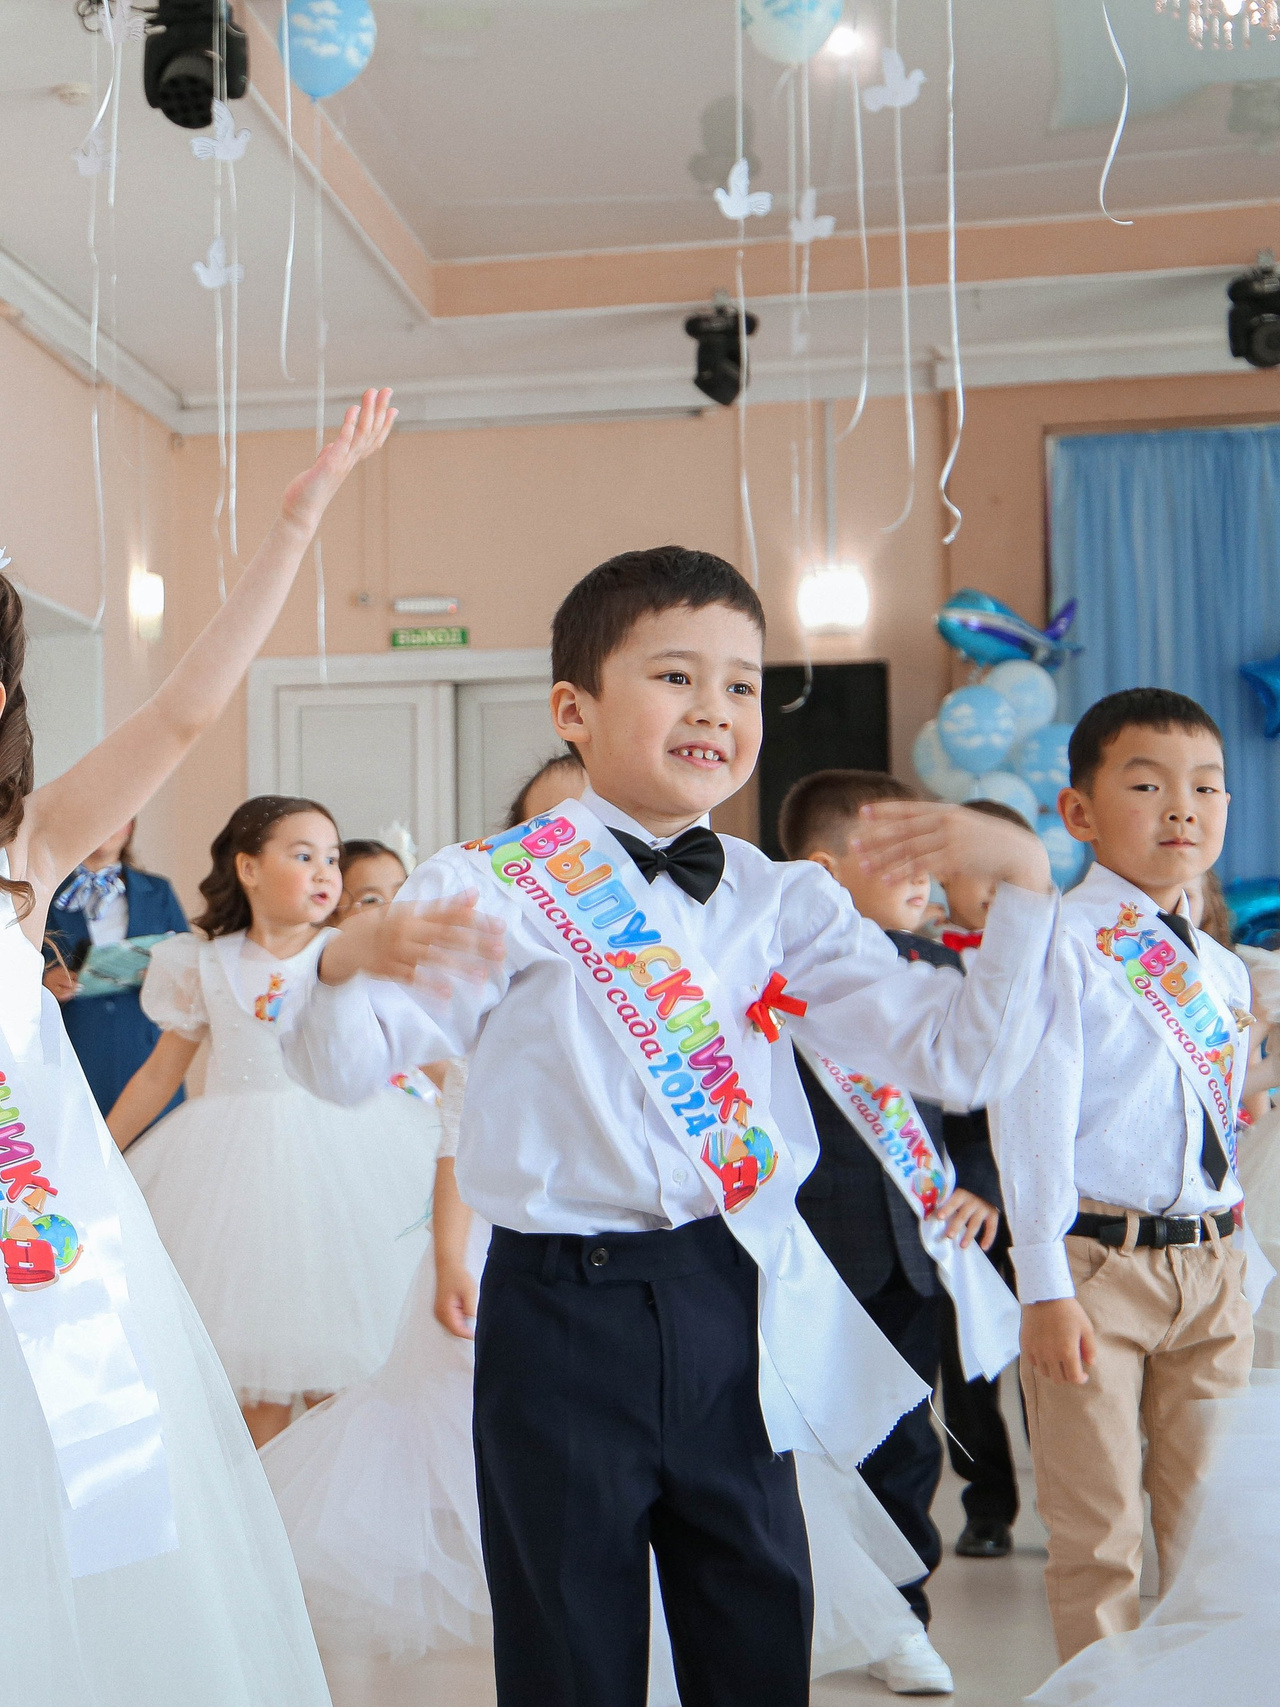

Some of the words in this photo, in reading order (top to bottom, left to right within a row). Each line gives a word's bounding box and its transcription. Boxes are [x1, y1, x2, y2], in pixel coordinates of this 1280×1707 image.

[502, 861, 613, 983] детского
[607, 987, 662, 1060] сада
[648, 1052, 719, 1137] 2024
[520, 815, 752, 1124] ВЫПУСКНИК
[1134, 975, 1211, 1075] детского
[1208, 1078, 1228, 1129] сада
[851, 1094, 884, 1135] сада
[878, 1130, 916, 1177] 2024
